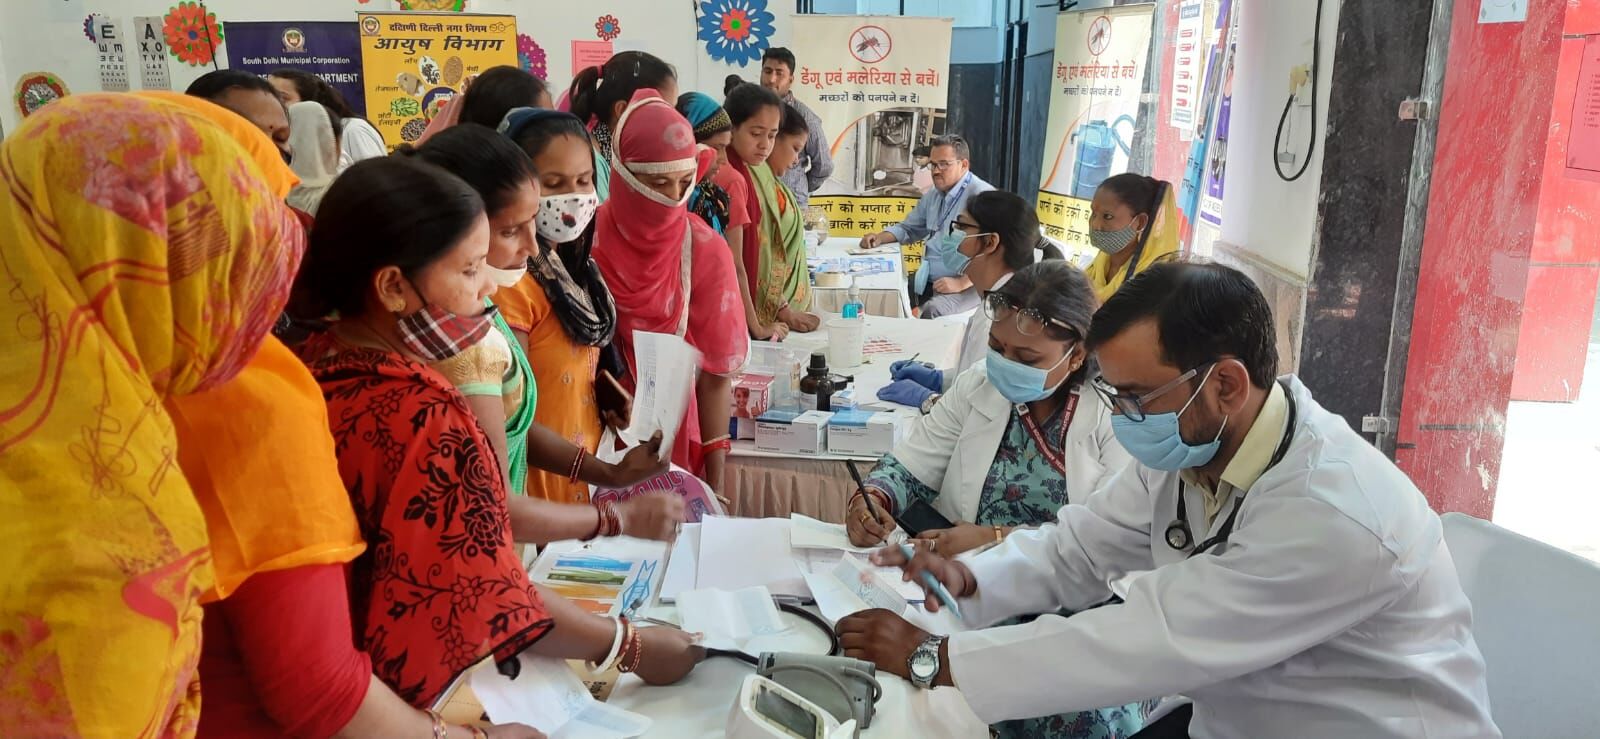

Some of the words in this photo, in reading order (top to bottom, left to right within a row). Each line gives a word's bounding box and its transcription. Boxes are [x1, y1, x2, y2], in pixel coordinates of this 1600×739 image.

[144, 24, 156, 40] A
[420, 23, 443, 32] दिल्ली
[446, 24, 462, 32] नगर
[465, 23, 487, 33] निगम
[141, 42, 149, 52] X
[374, 38, 434, 55] आयुष
[443, 35, 505, 51] विभाग
[242, 57, 261, 65] South
[263, 57, 279, 65] Delhi
[280, 56, 311, 65] Municipal
[312, 56, 350, 65] Corporation
[315, 73, 359, 83] ARTMENT
[801, 67, 824, 90] डेंगू
[825, 68, 842, 85] एवं
[847, 66, 896, 85] मलेरिया
[900, 67, 911, 86] से
[852, 91, 865, 102] को
[868, 91, 896, 102] पनपने
[899, 94, 907, 102] न
[839, 201, 854, 213] को
[860, 204, 892, 215] सप्ताह
[897, 201, 906, 213] में
[858, 218, 876, 230] करें
